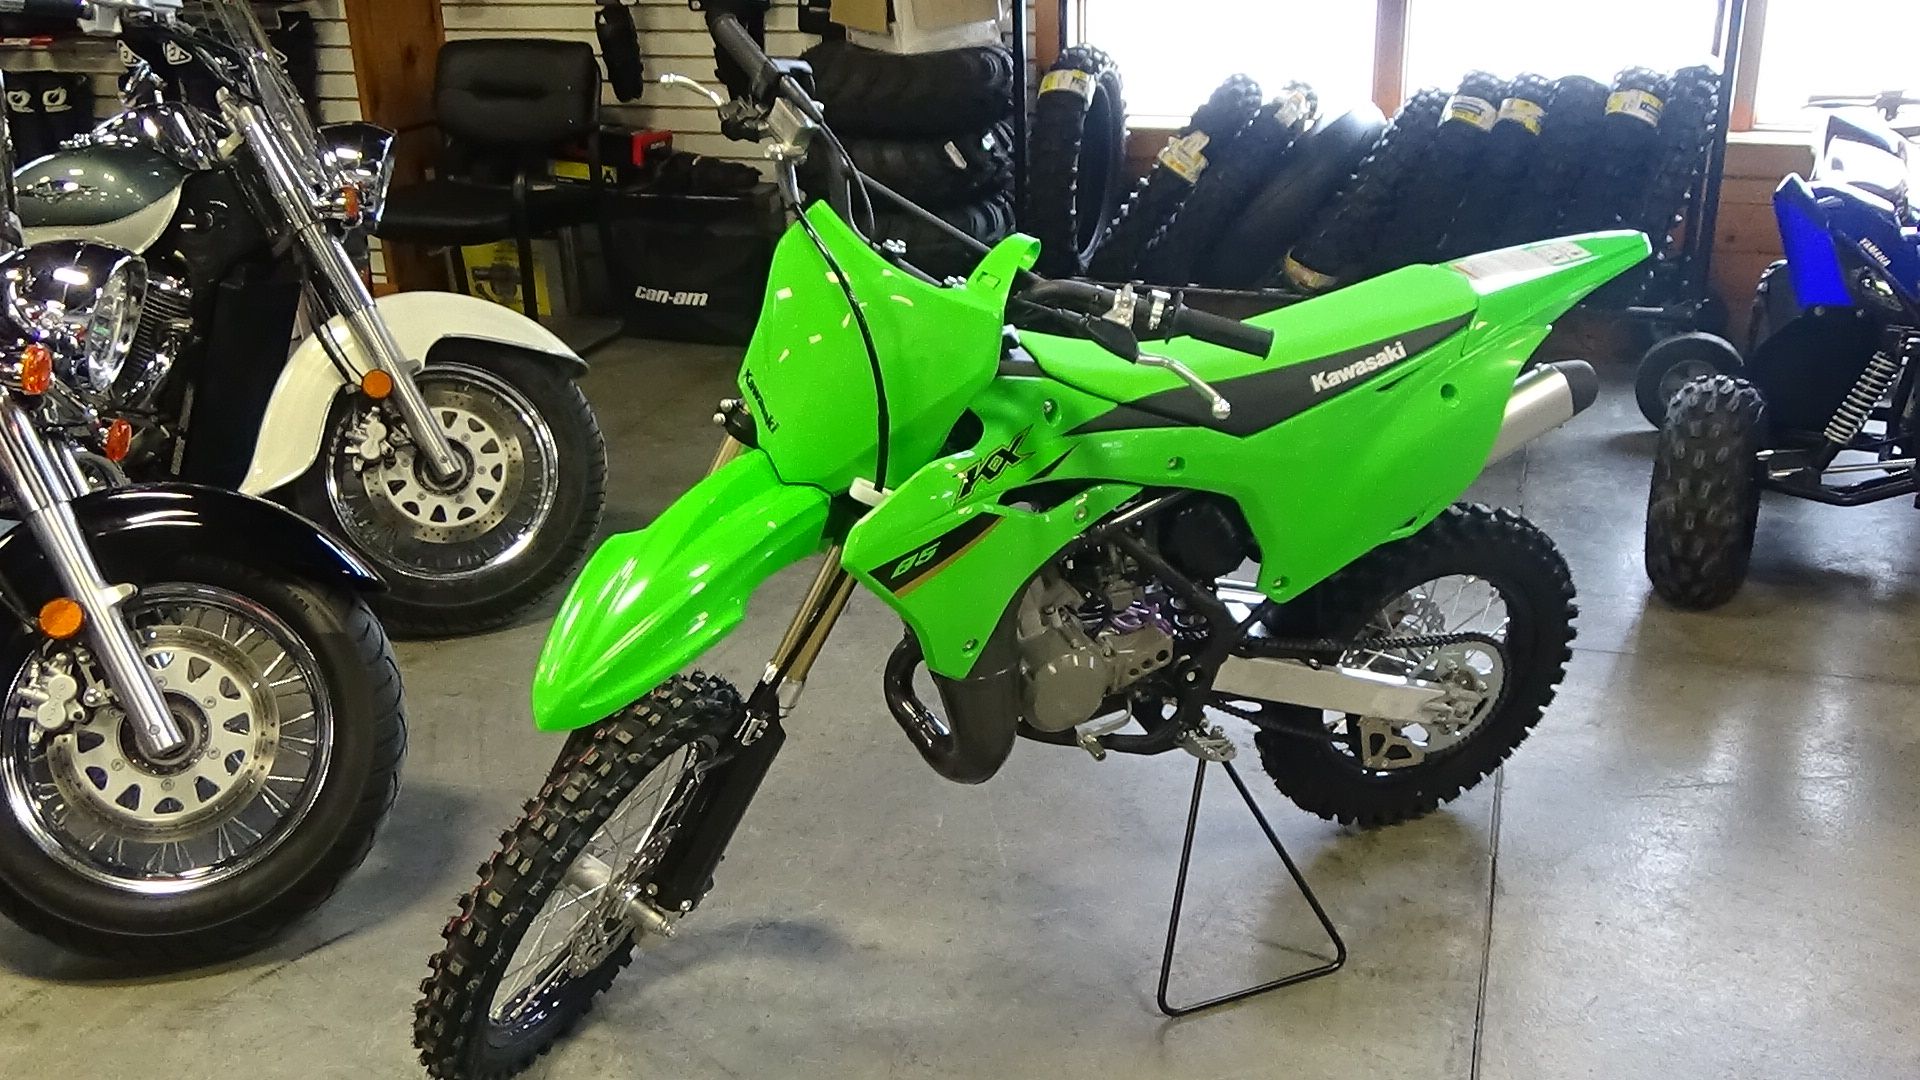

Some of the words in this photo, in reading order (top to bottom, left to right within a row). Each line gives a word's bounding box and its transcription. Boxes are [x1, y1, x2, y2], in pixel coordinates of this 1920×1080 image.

[1859, 237, 1892, 267] YAMAHA
[1310, 340, 1407, 393] Kawasaki
[744, 368, 780, 434] Kawasaki
[890, 541, 942, 580] 85
